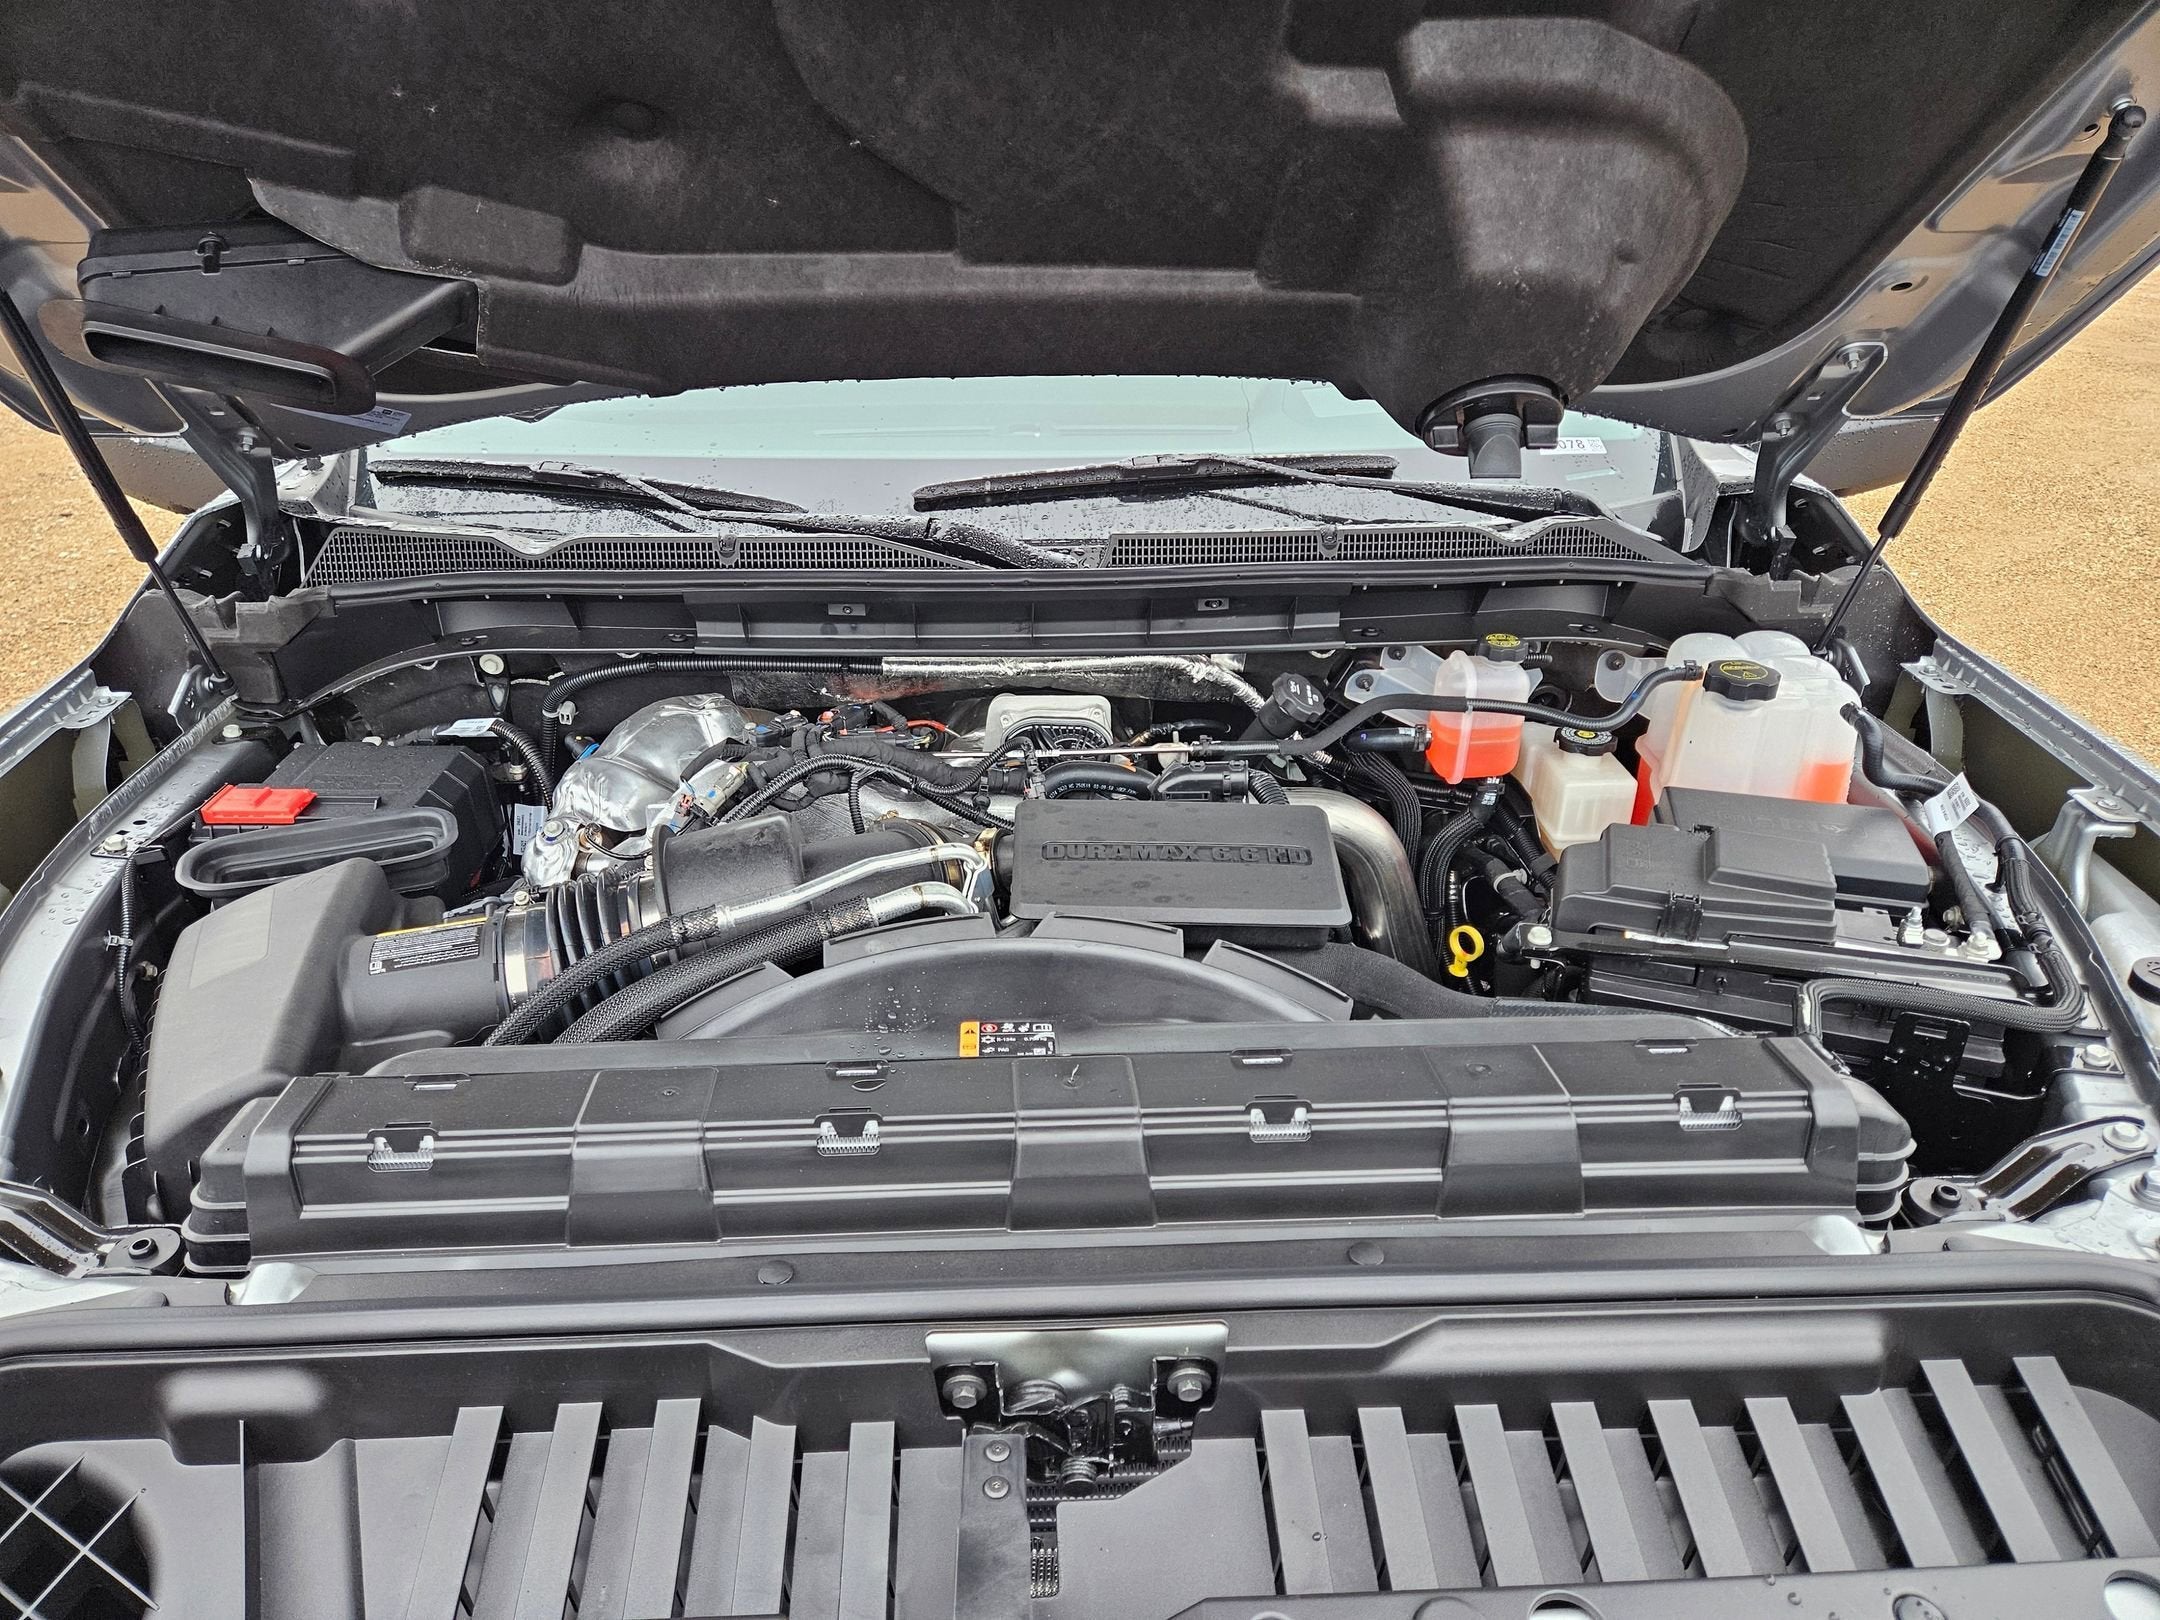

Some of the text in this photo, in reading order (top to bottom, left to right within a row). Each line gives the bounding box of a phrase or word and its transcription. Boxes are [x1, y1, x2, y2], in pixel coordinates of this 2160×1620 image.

[1046, 843, 1311, 865] DURAMAX 6.6 HD
